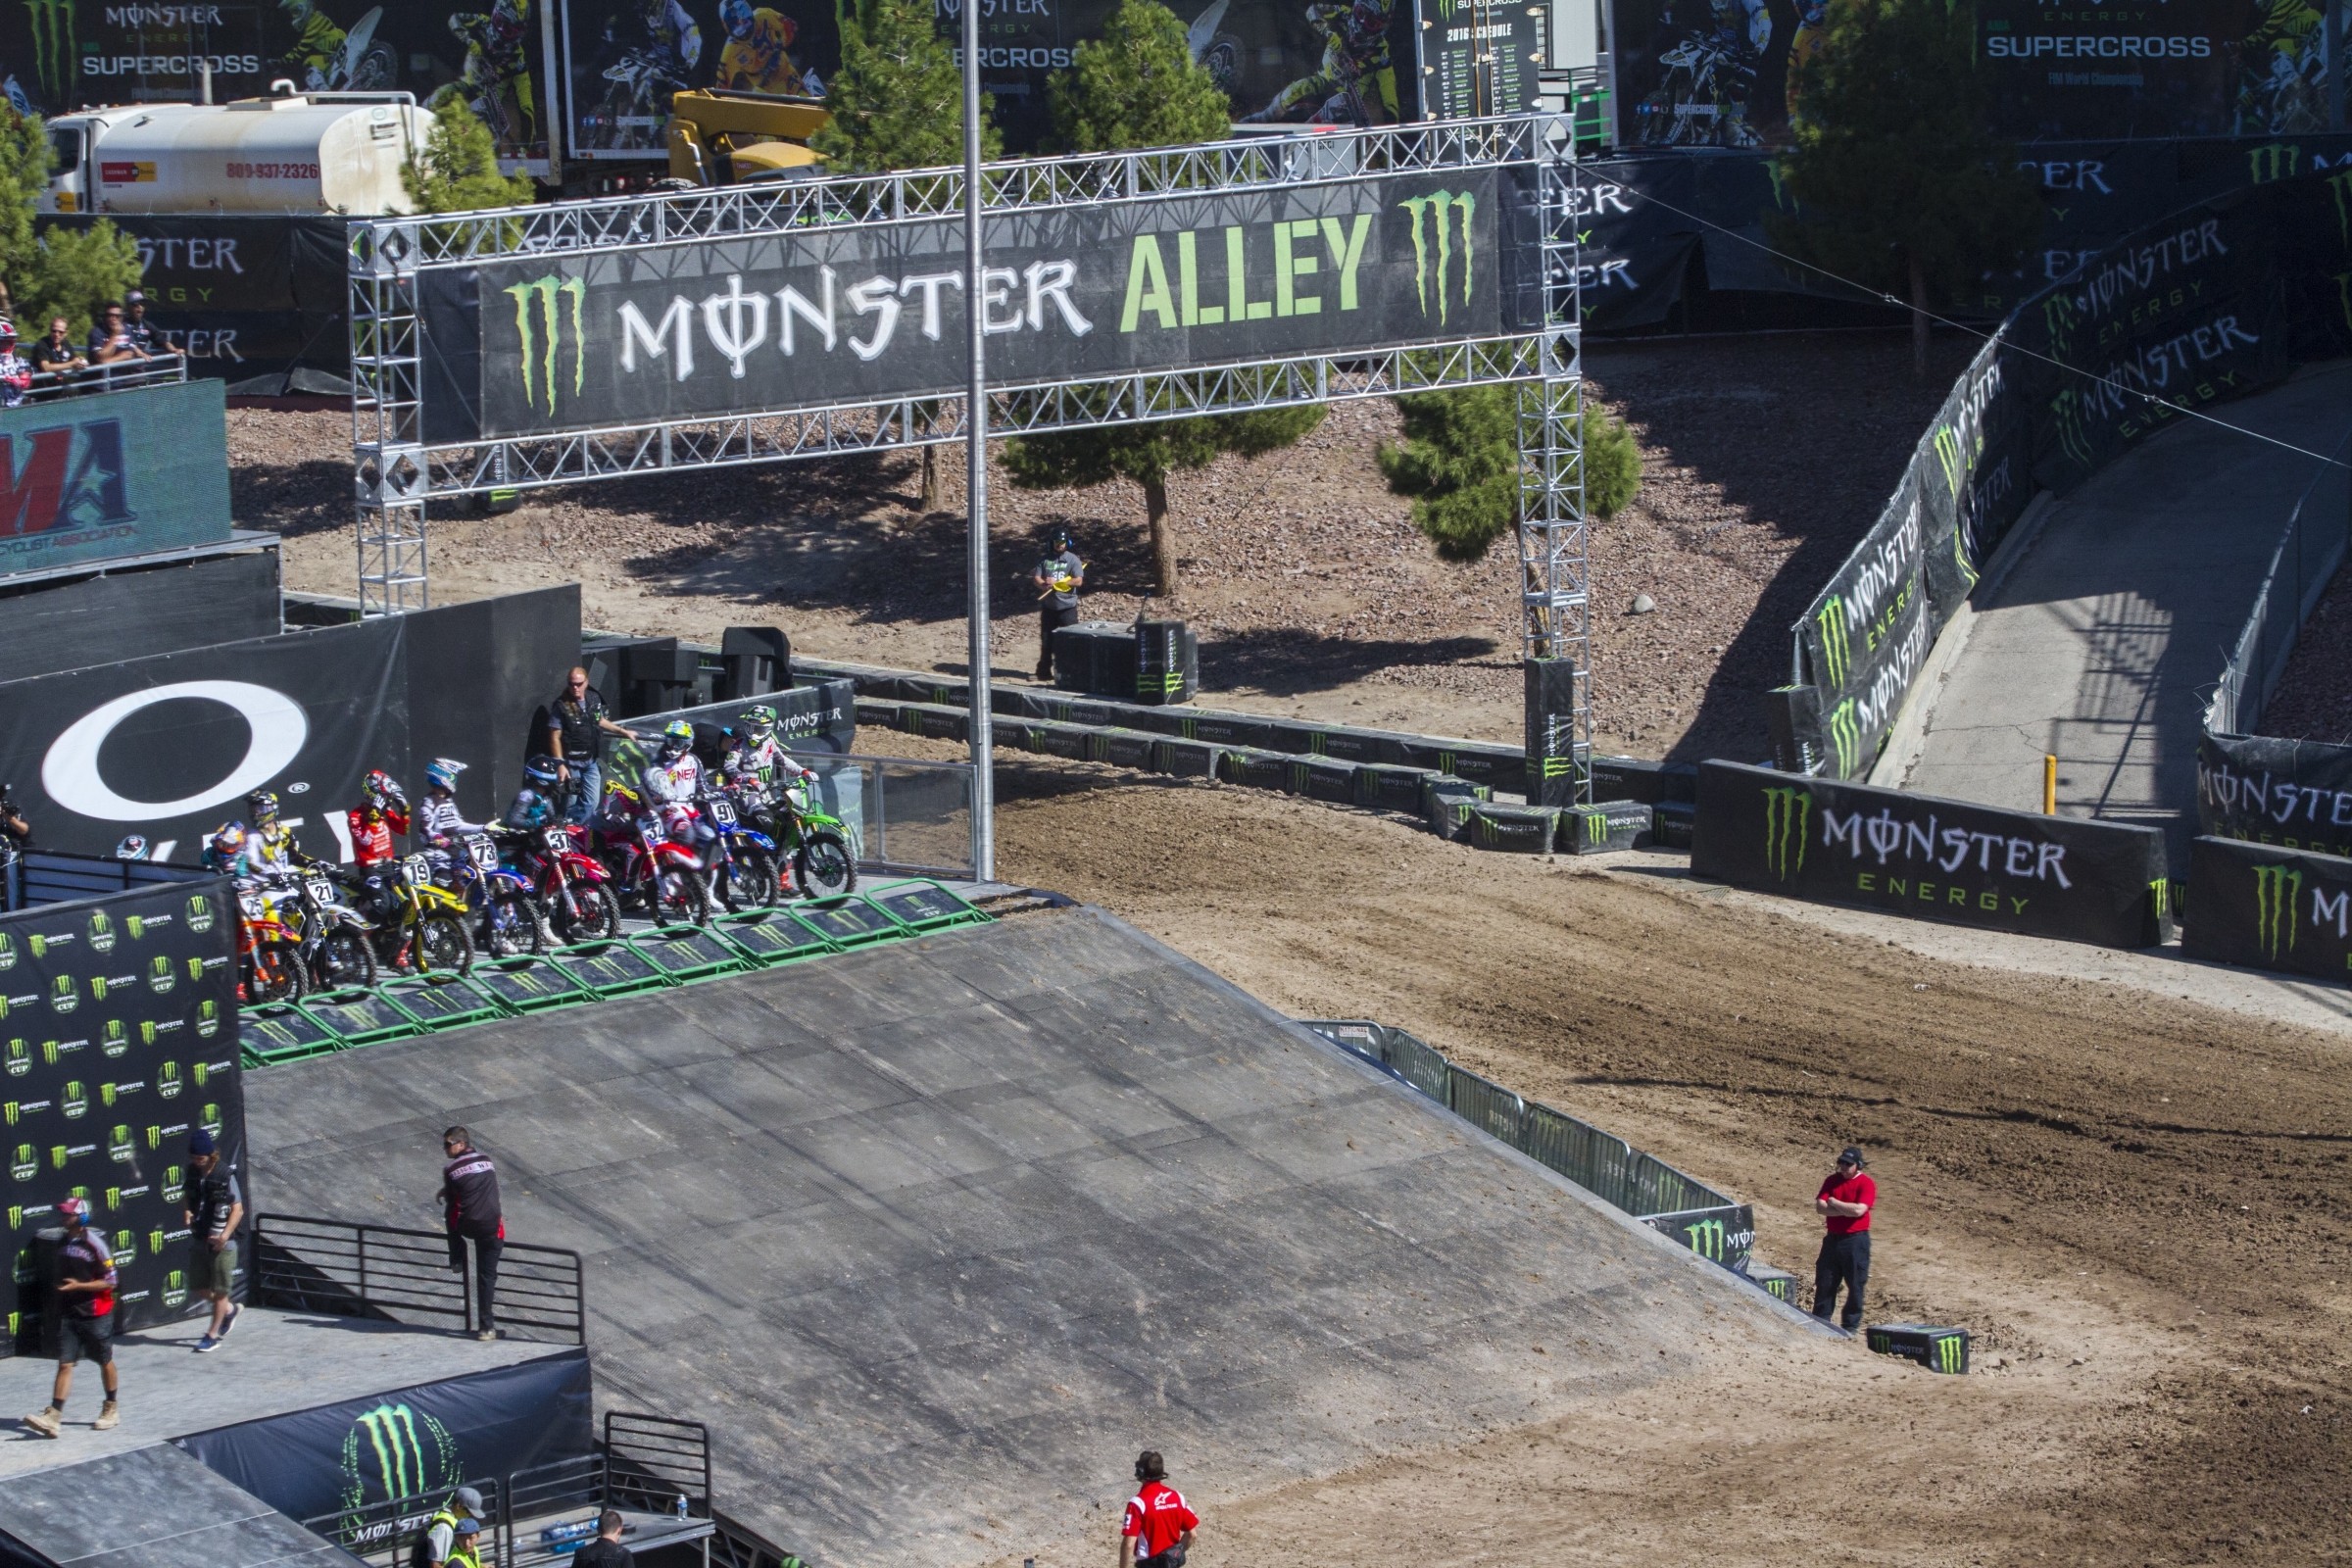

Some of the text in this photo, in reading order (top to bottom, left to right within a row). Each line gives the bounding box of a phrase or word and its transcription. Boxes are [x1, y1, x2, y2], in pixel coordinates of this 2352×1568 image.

[105, 2, 223, 28] MONSTER
[2044, 11, 2148, 23] ENERGY
[941, 24, 1031, 34] ERGY
[1447, 23, 1512, 42] 2016 CHEDULE
[1986, 36, 2212, 58] SUPERCROSS
[617, 214, 1372, 382] MONSTER ALLEY
[776, 707, 843, 732] MONSTER
[788, 727, 829, 741] ENERG
[1197, 724, 1232, 736] MONSTER
[1326, 738, 1362, 751] MONSTER
[1455, 758, 1493, 769] MONSTER
[717, 804, 735, 822] 91
[1606, 814, 1647, 828] MONSTER
[474, 844, 497, 863] 73
[1821, 808, 2073, 890] MONSTER
[410, 864, 429, 881] 19
[315, 884, 332, 902] 21
[1857, 872, 2030, 915] ENERGY
[247, 898, 264, 916] 25
[155, 1019, 184, 1031] MONSTER
[1890, 1343, 1924, 1355] MONSTER
[354, 1512, 439, 1544] MOSTE
